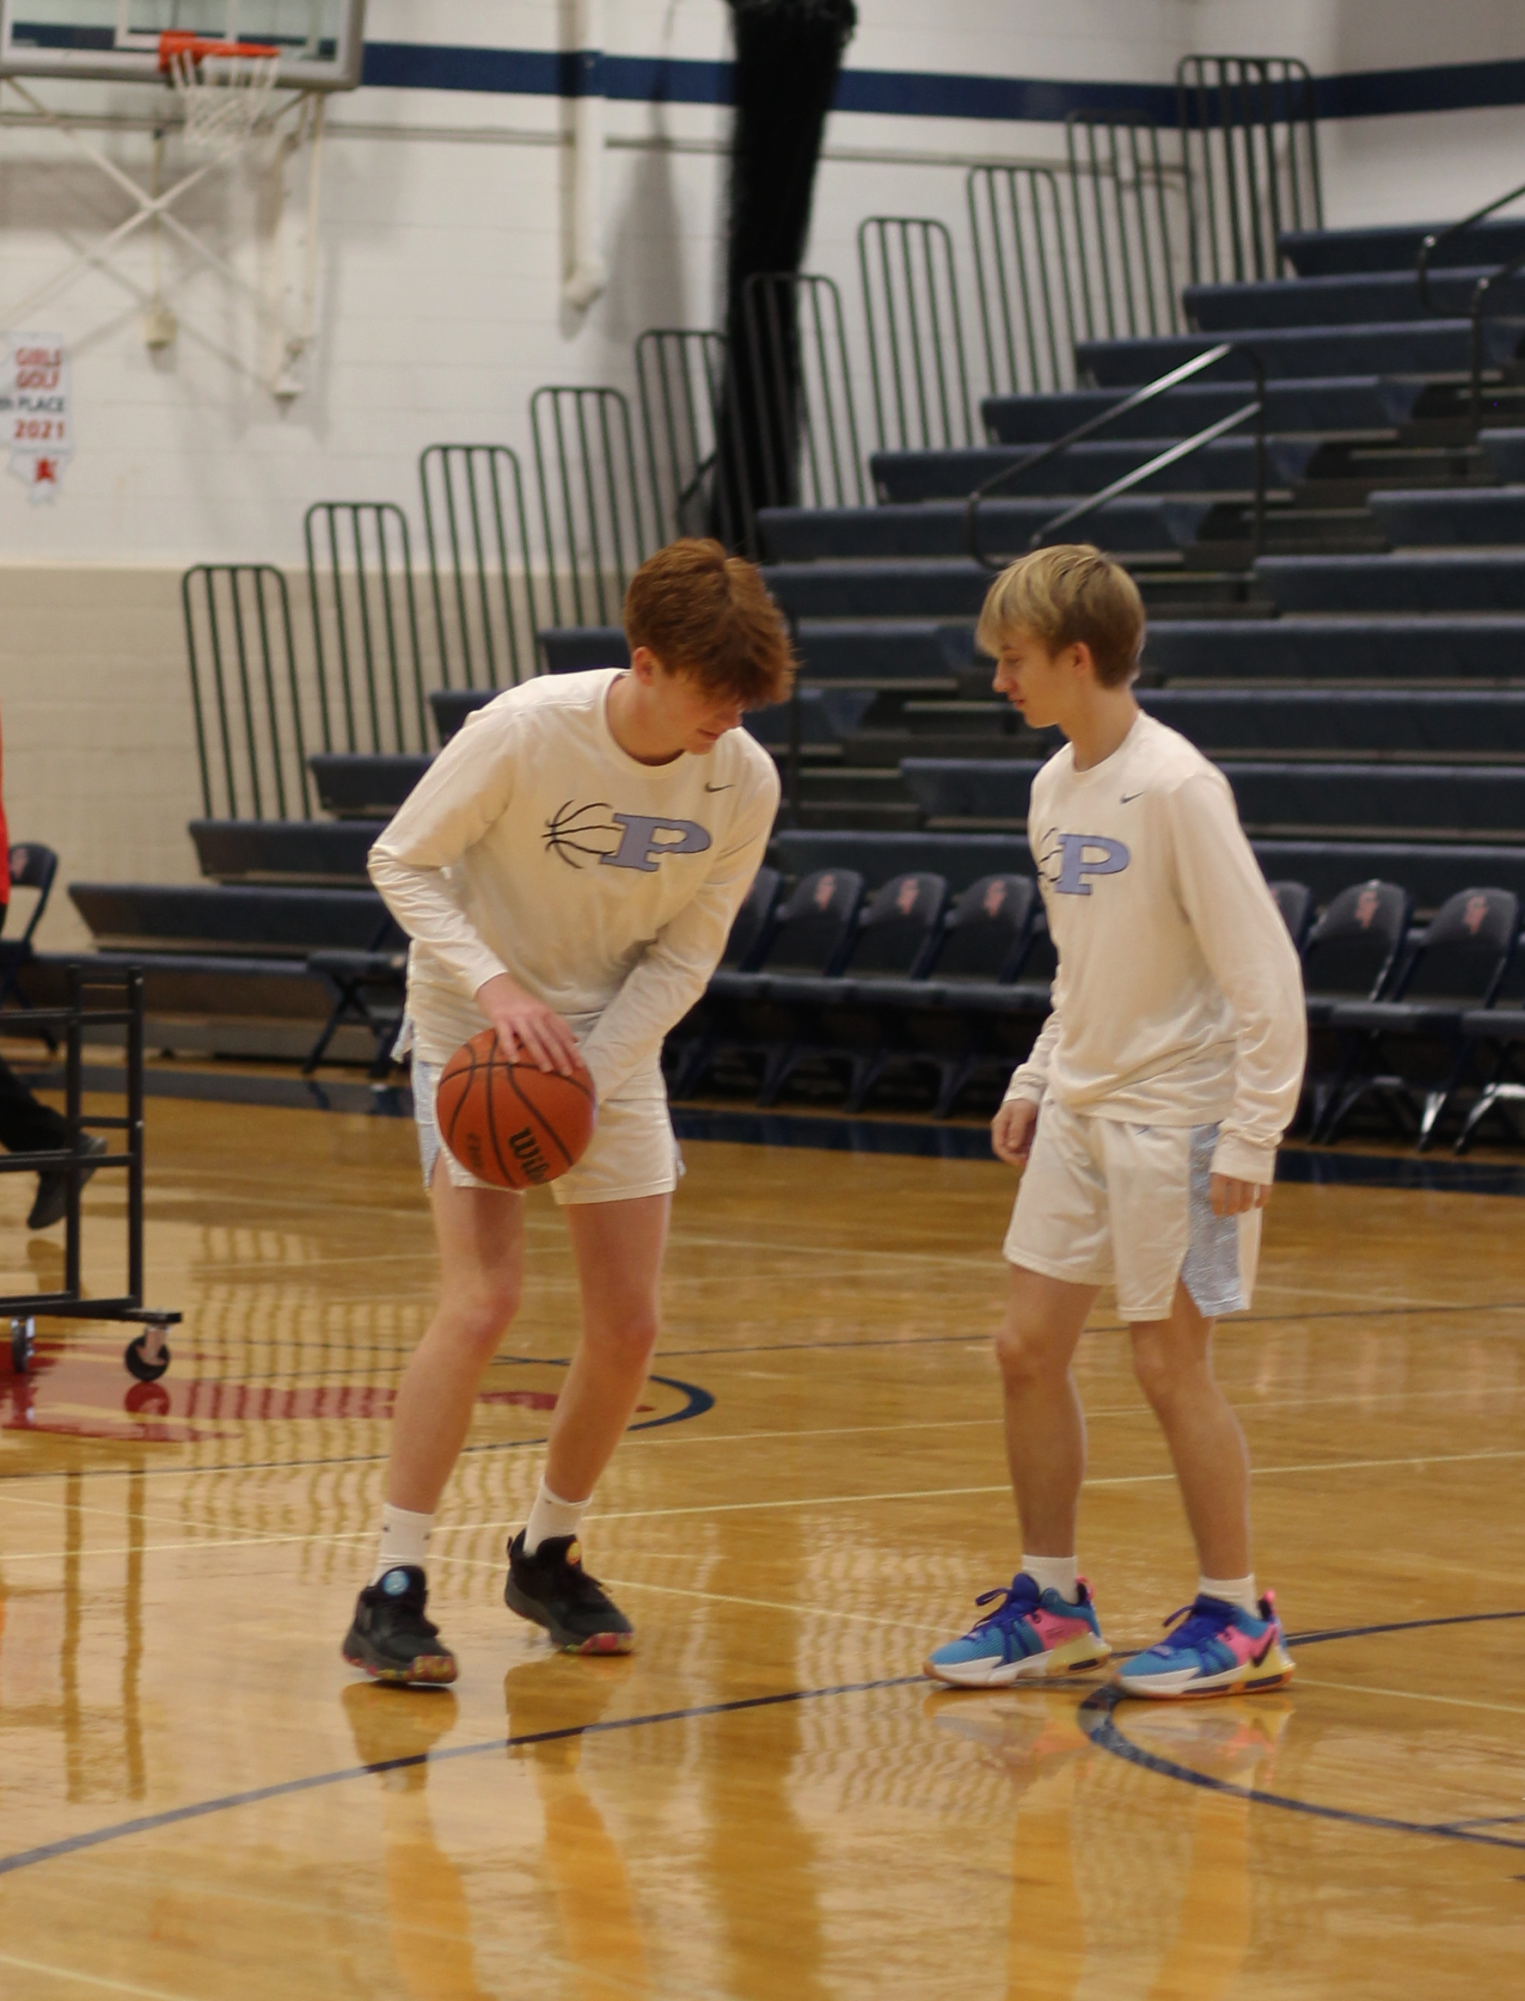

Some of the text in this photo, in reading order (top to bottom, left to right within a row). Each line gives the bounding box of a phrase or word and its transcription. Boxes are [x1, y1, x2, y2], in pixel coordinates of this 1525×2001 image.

[16, 370, 59, 388] GOLF
[18, 397, 64, 412] PLACE
[15, 420, 64, 439] 2021
[598, 812, 712, 872] P
[1054, 833, 1131, 896] P
